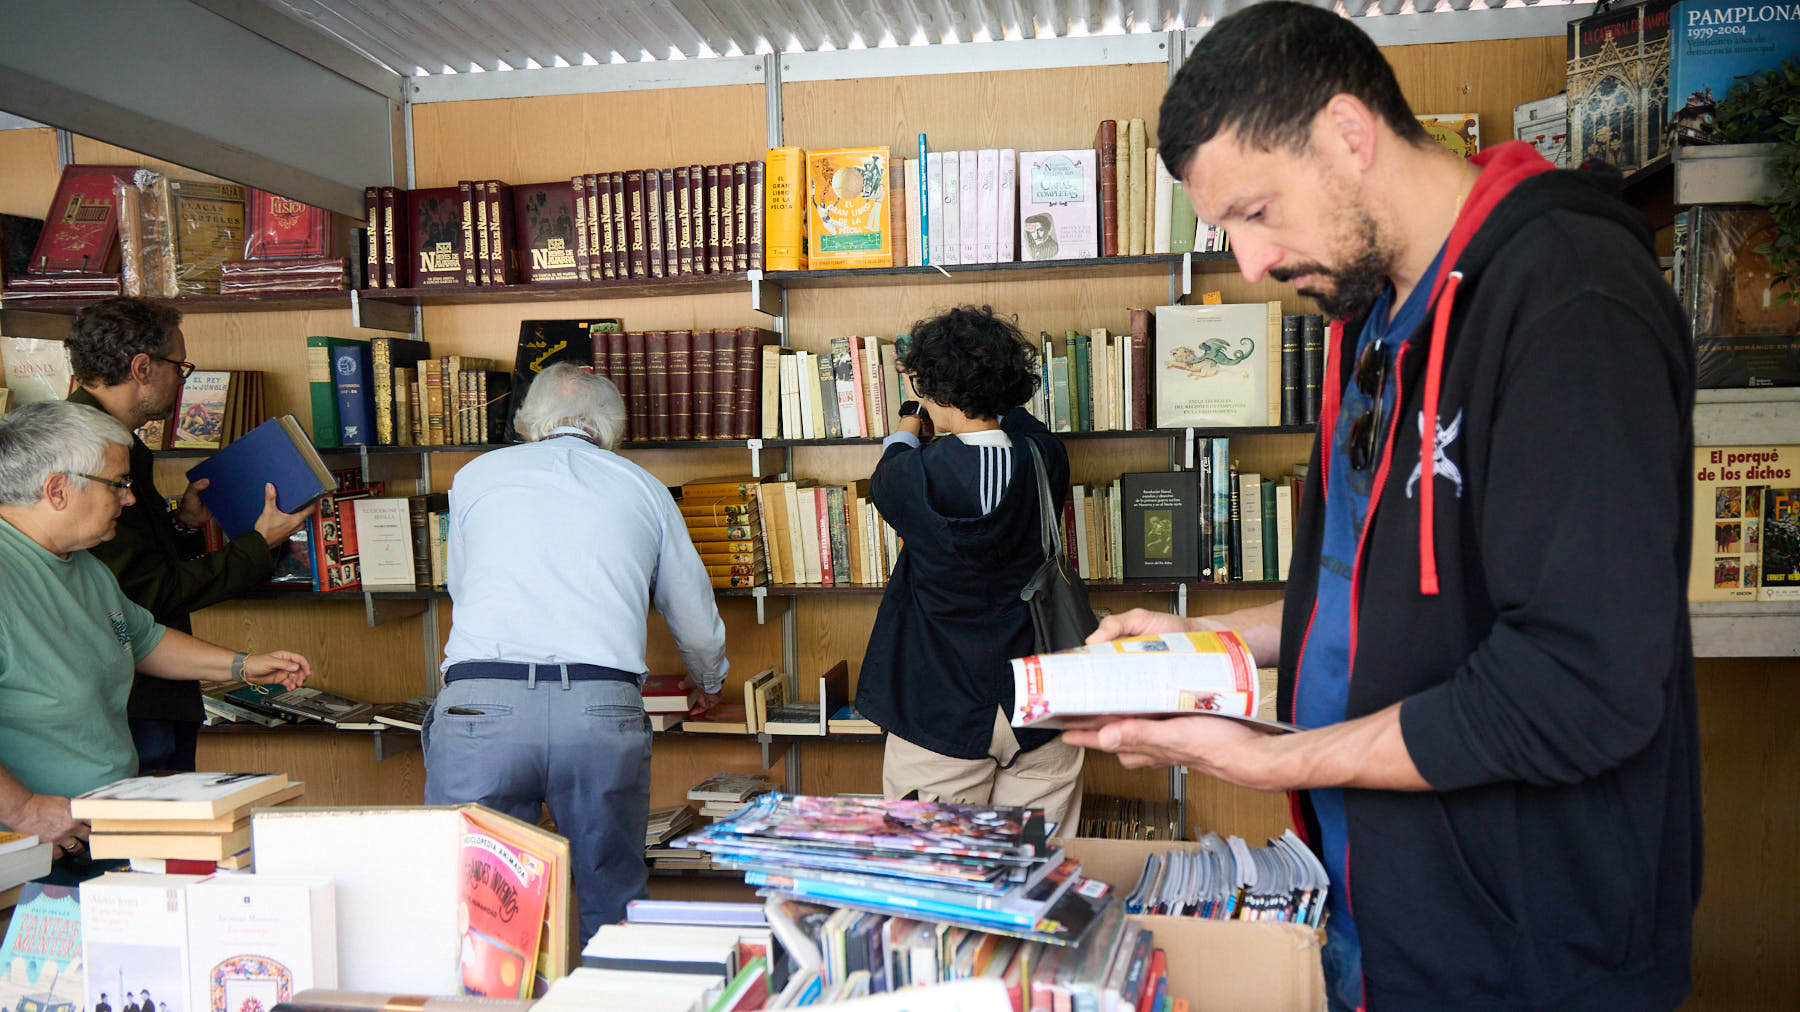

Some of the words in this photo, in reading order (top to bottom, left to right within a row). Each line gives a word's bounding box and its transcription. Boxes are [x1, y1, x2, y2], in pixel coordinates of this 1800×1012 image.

[1687, 5, 1800, 26] PAMPLONA
[1687, 26, 1746, 39] 1979-2004
[1710, 450, 1723, 464] El
[1727, 449, 1779, 467] porqué
[1697, 467, 1716, 482] de
[1720, 467, 1741, 481] los
[1745, 465, 1791, 480] dichos
[499, 848, 526, 880] ANIMADA
[490, 866, 519, 923] INVENTOS
[19, 913, 80, 936] TANTAS
[12, 933, 82, 959] MENTIRA
